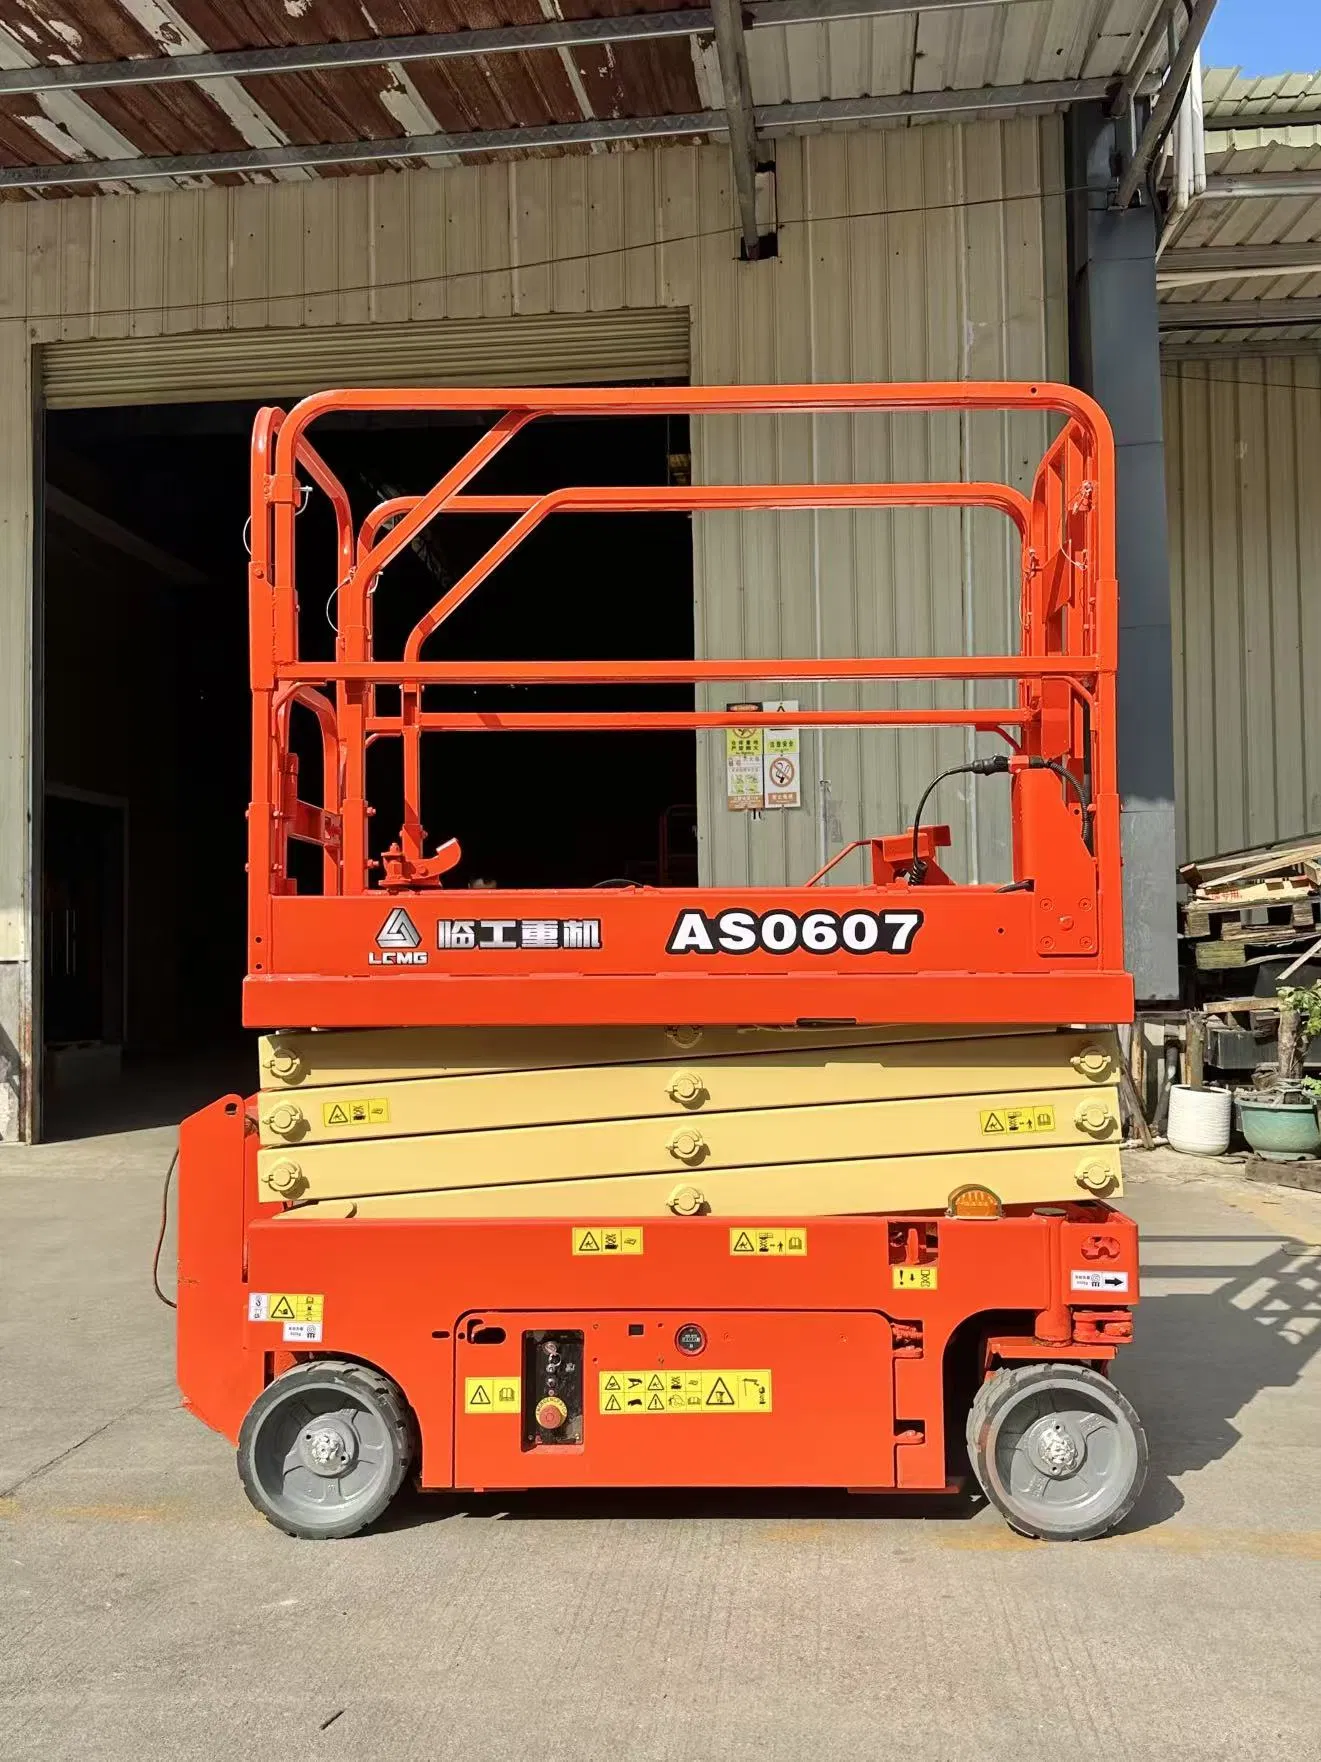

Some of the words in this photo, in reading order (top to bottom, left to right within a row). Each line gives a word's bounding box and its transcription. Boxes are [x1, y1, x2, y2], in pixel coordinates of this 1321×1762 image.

[438, 919, 601, 949] 临工重机
[670, 911, 920, 952] AS0607
[368, 952, 428, 964] LCMG
